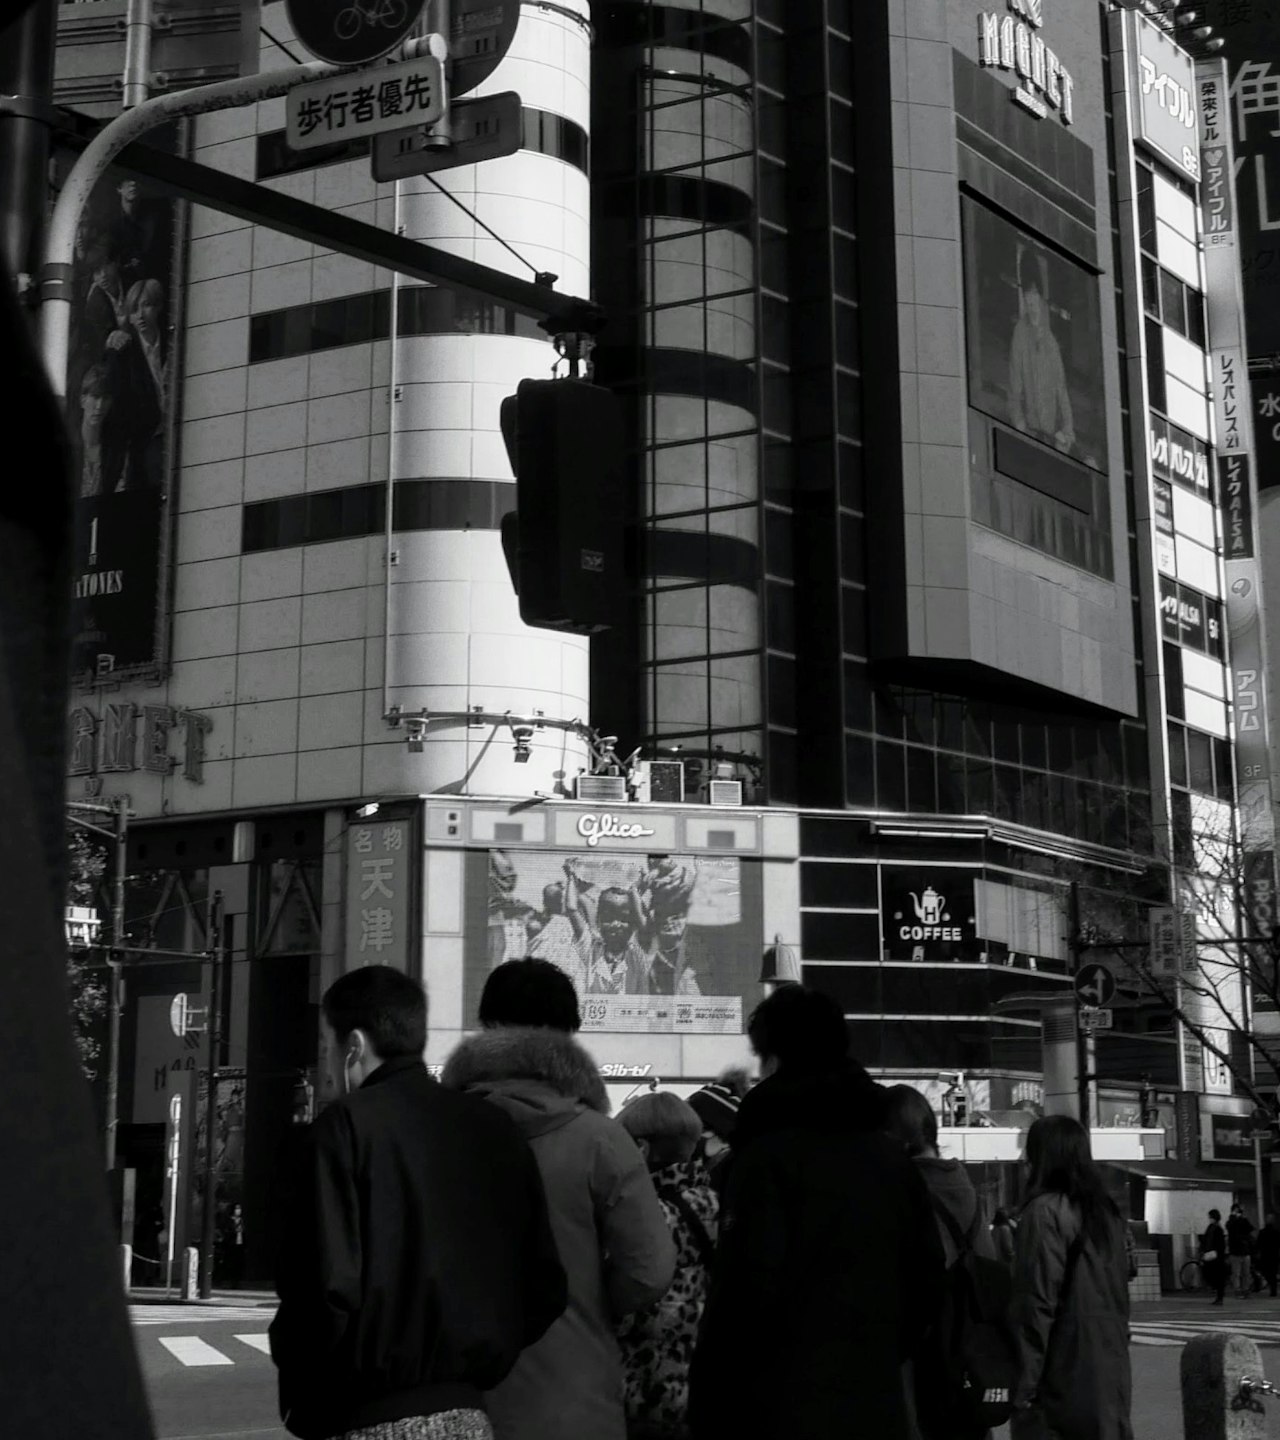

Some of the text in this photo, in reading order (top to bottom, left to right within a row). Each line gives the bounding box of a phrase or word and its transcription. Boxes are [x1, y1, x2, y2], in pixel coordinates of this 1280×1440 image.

[977, 12, 1074, 126] MAGNET
[1140, 54, 1195, 129] アイフル
[297, 73, 431, 136] 歩行者優先
[1207, 167, 1227, 232] アイフル
[1221, 355, 1240, 449] レオパレス21
[1226, 456, 1246, 550] レイクALSA
[1237, 669, 1260, 731] アコム
[1244, 764, 1262, 777] 3F
[355, 826, 403, 853] 名物
[578, 813, 655, 848] Glico
[360, 858, 394, 966] 天津
[899, 925, 963, 941] COFFEE
[924, 905, 937, 922] H
